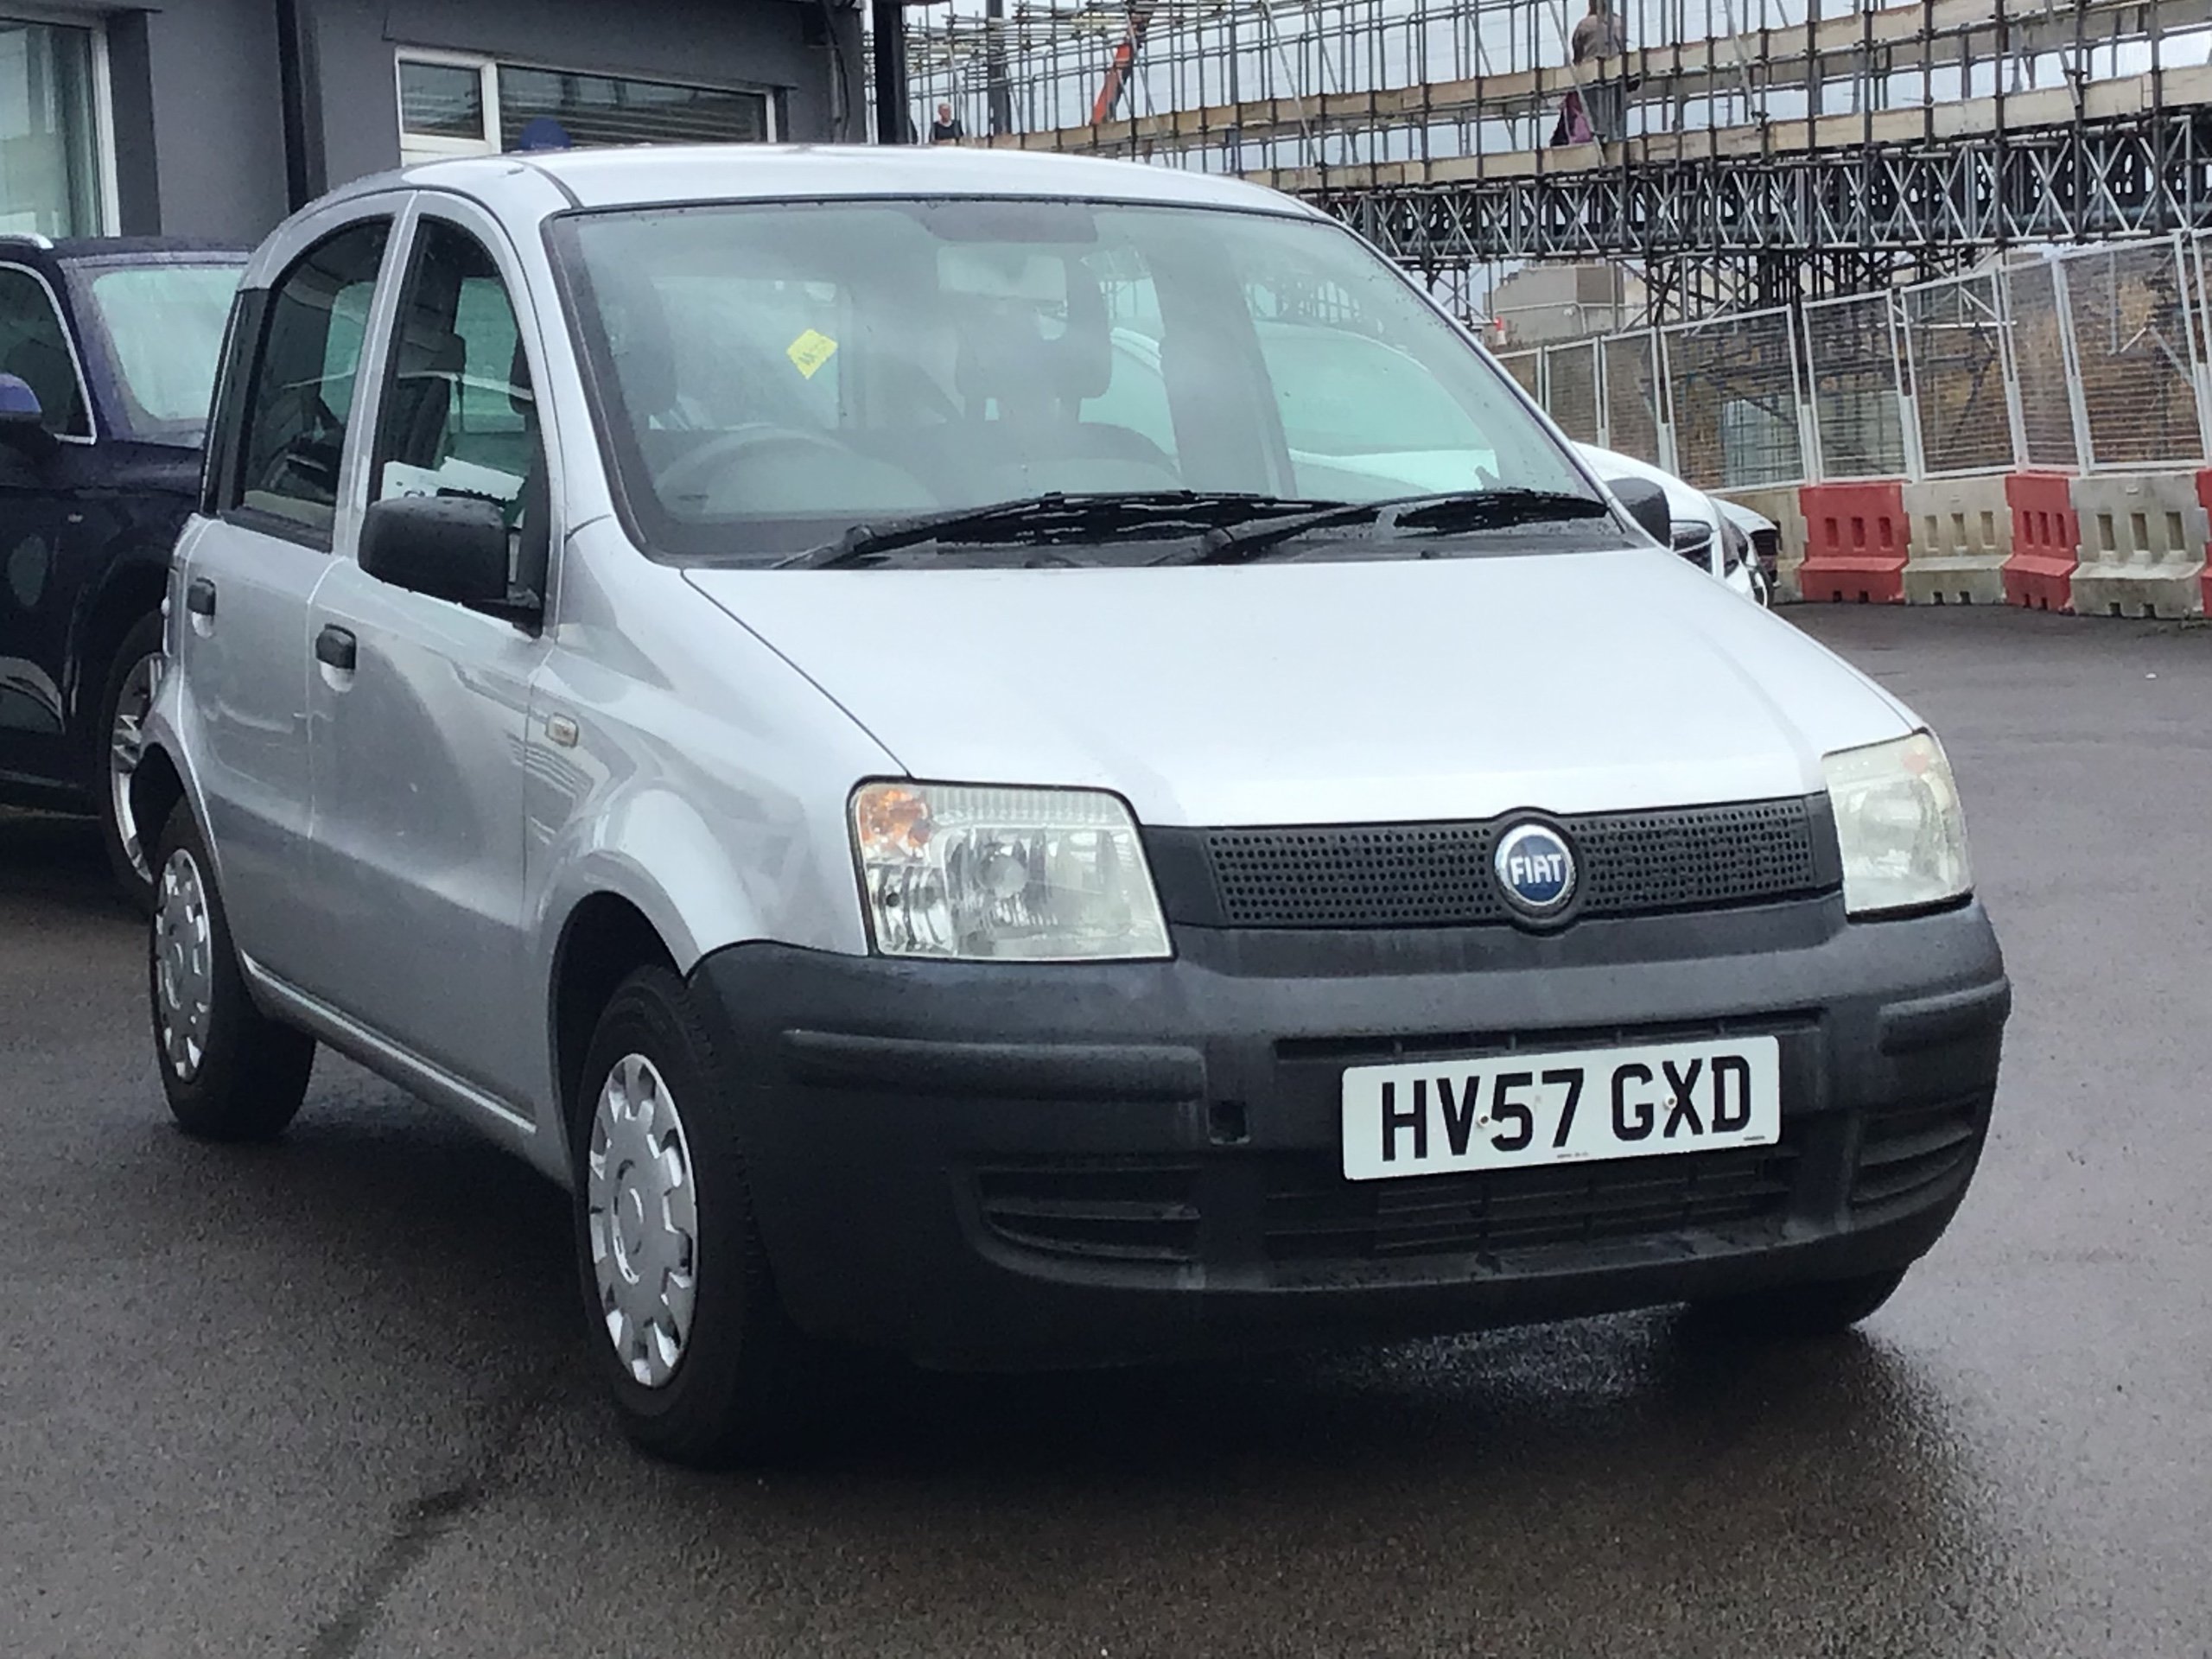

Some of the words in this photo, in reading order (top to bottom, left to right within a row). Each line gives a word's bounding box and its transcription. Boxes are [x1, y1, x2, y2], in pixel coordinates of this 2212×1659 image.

[1510, 854, 1561, 885] FIAT
[1382, 1068, 1585, 1161] HV57
[1611, 1055, 1751, 1141] GXD
